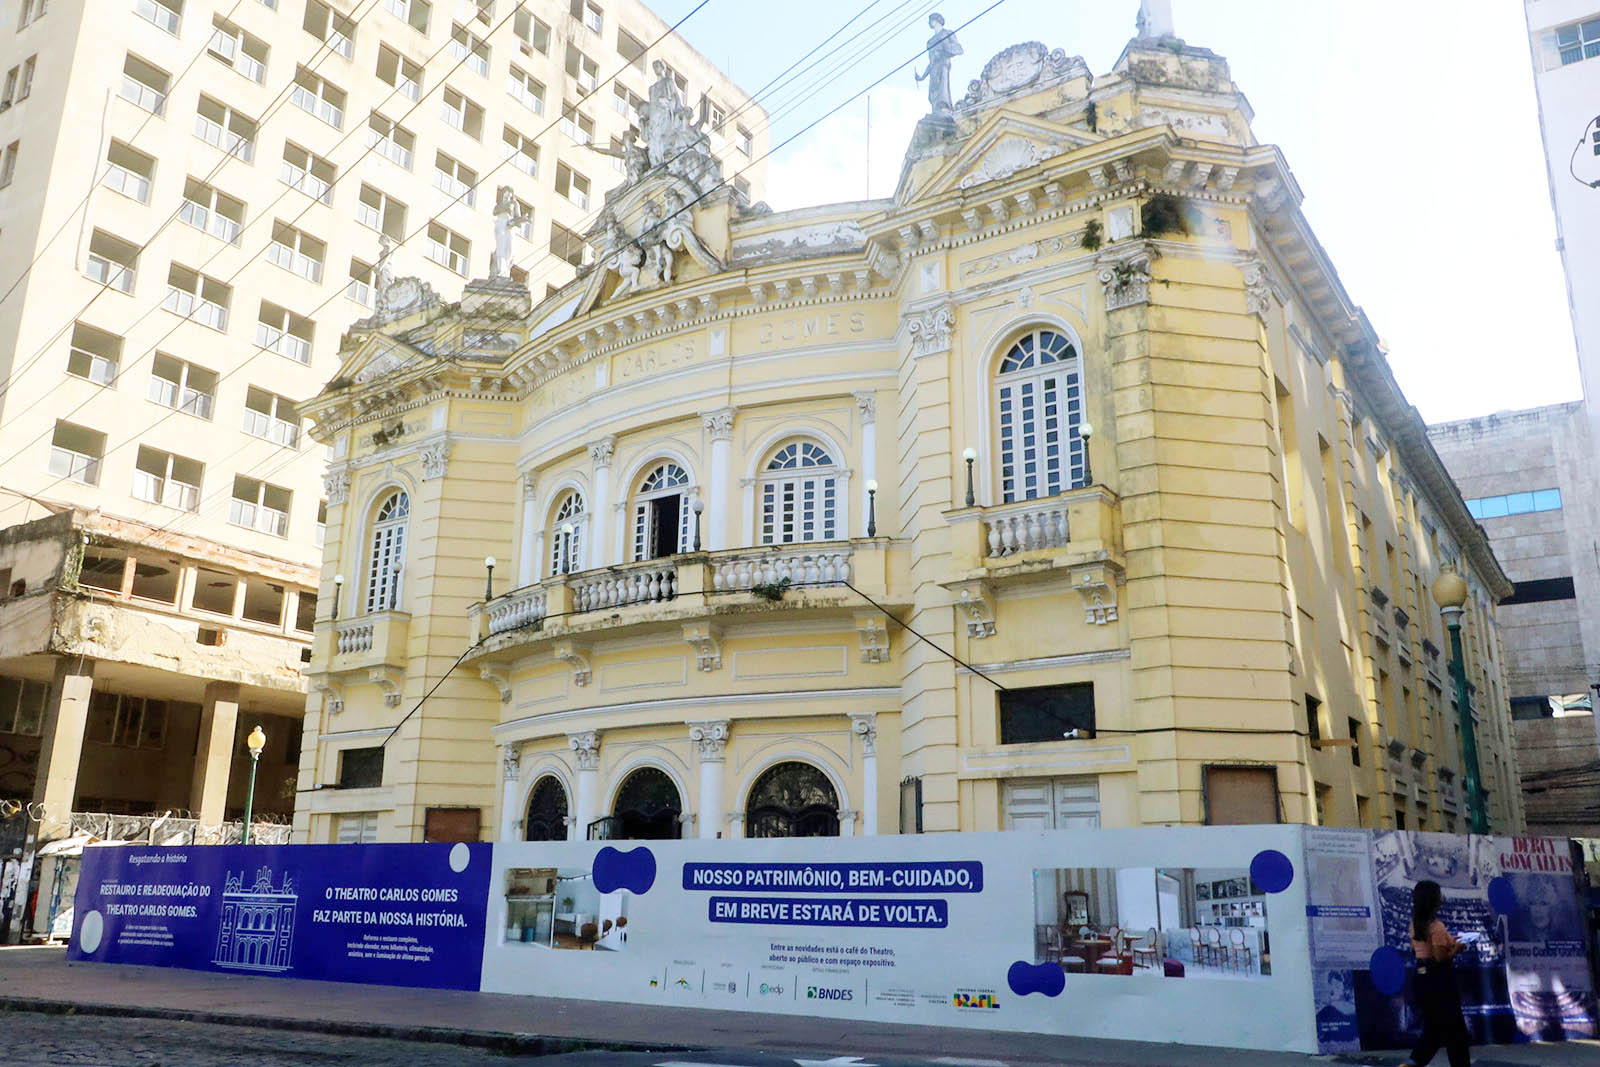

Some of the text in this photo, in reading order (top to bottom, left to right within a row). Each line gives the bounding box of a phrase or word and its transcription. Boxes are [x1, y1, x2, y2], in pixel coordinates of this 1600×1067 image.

[759, 311, 866, 345] GOMES
[129, 853, 161, 866] Resgatando
[166, 853, 188, 864] história
[693, 866, 974, 890] NOSSO PATRIMÔNIO, BEM-CUIDADO,
[100, 882, 211, 899] RESTAURO E READEQUAÇÃO DO
[325, 887, 458, 902] O THEATRO CARLOS GOMES
[107, 904, 198, 917] THEATRO CARLOS GOMES.
[715, 901, 943, 923] EM BREVE ESTARÁ DE VOLTA.
[313, 910, 468, 927] FAZ PARTE DA NOSSA HISTÓRIA.
[770, 943, 786, 951] Entre
[795, 944, 825, 953] novidades
[825, 945, 839, 954] está
[845, 945, 859, 955] café
[860, 946, 868, 955] do
[869, 946, 896, 957] Theatro,
[769, 954, 788, 962] aberto
[797, 955, 818, 965] público
[839, 959, 861, 968] espaço
[862, 958, 896, 968] expositivo.
[818, 988, 853, 1001] BNDES
[953, 993, 1000, 1009] BRASIL
